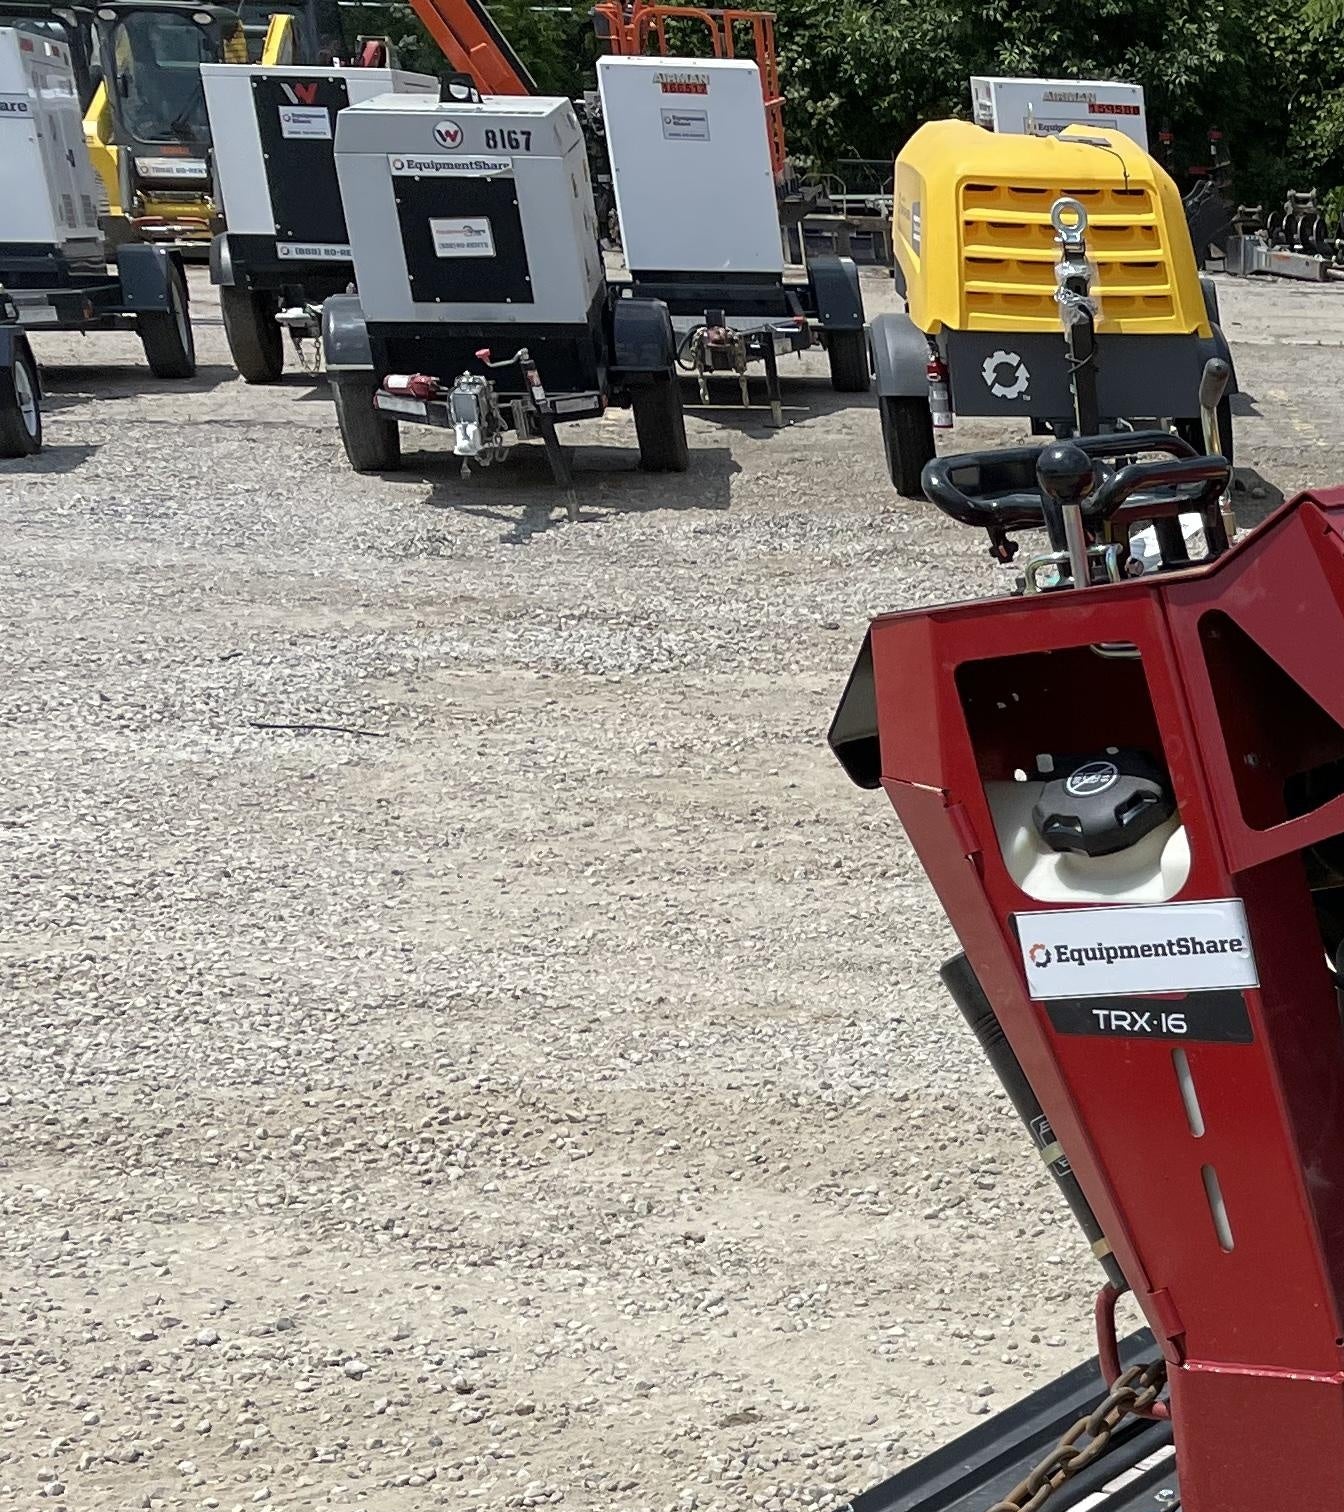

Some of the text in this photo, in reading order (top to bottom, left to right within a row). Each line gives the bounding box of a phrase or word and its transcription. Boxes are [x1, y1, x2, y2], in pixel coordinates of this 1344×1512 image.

[652, 71, 710, 85] AIRMAN
[1042, 90, 1097, 103] AIRMAN
[484, 128, 532, 151] 8167
[406, 160, 510, 171] EquipmentShare
[1054, 936, 1244, 964] EquipmentShare
